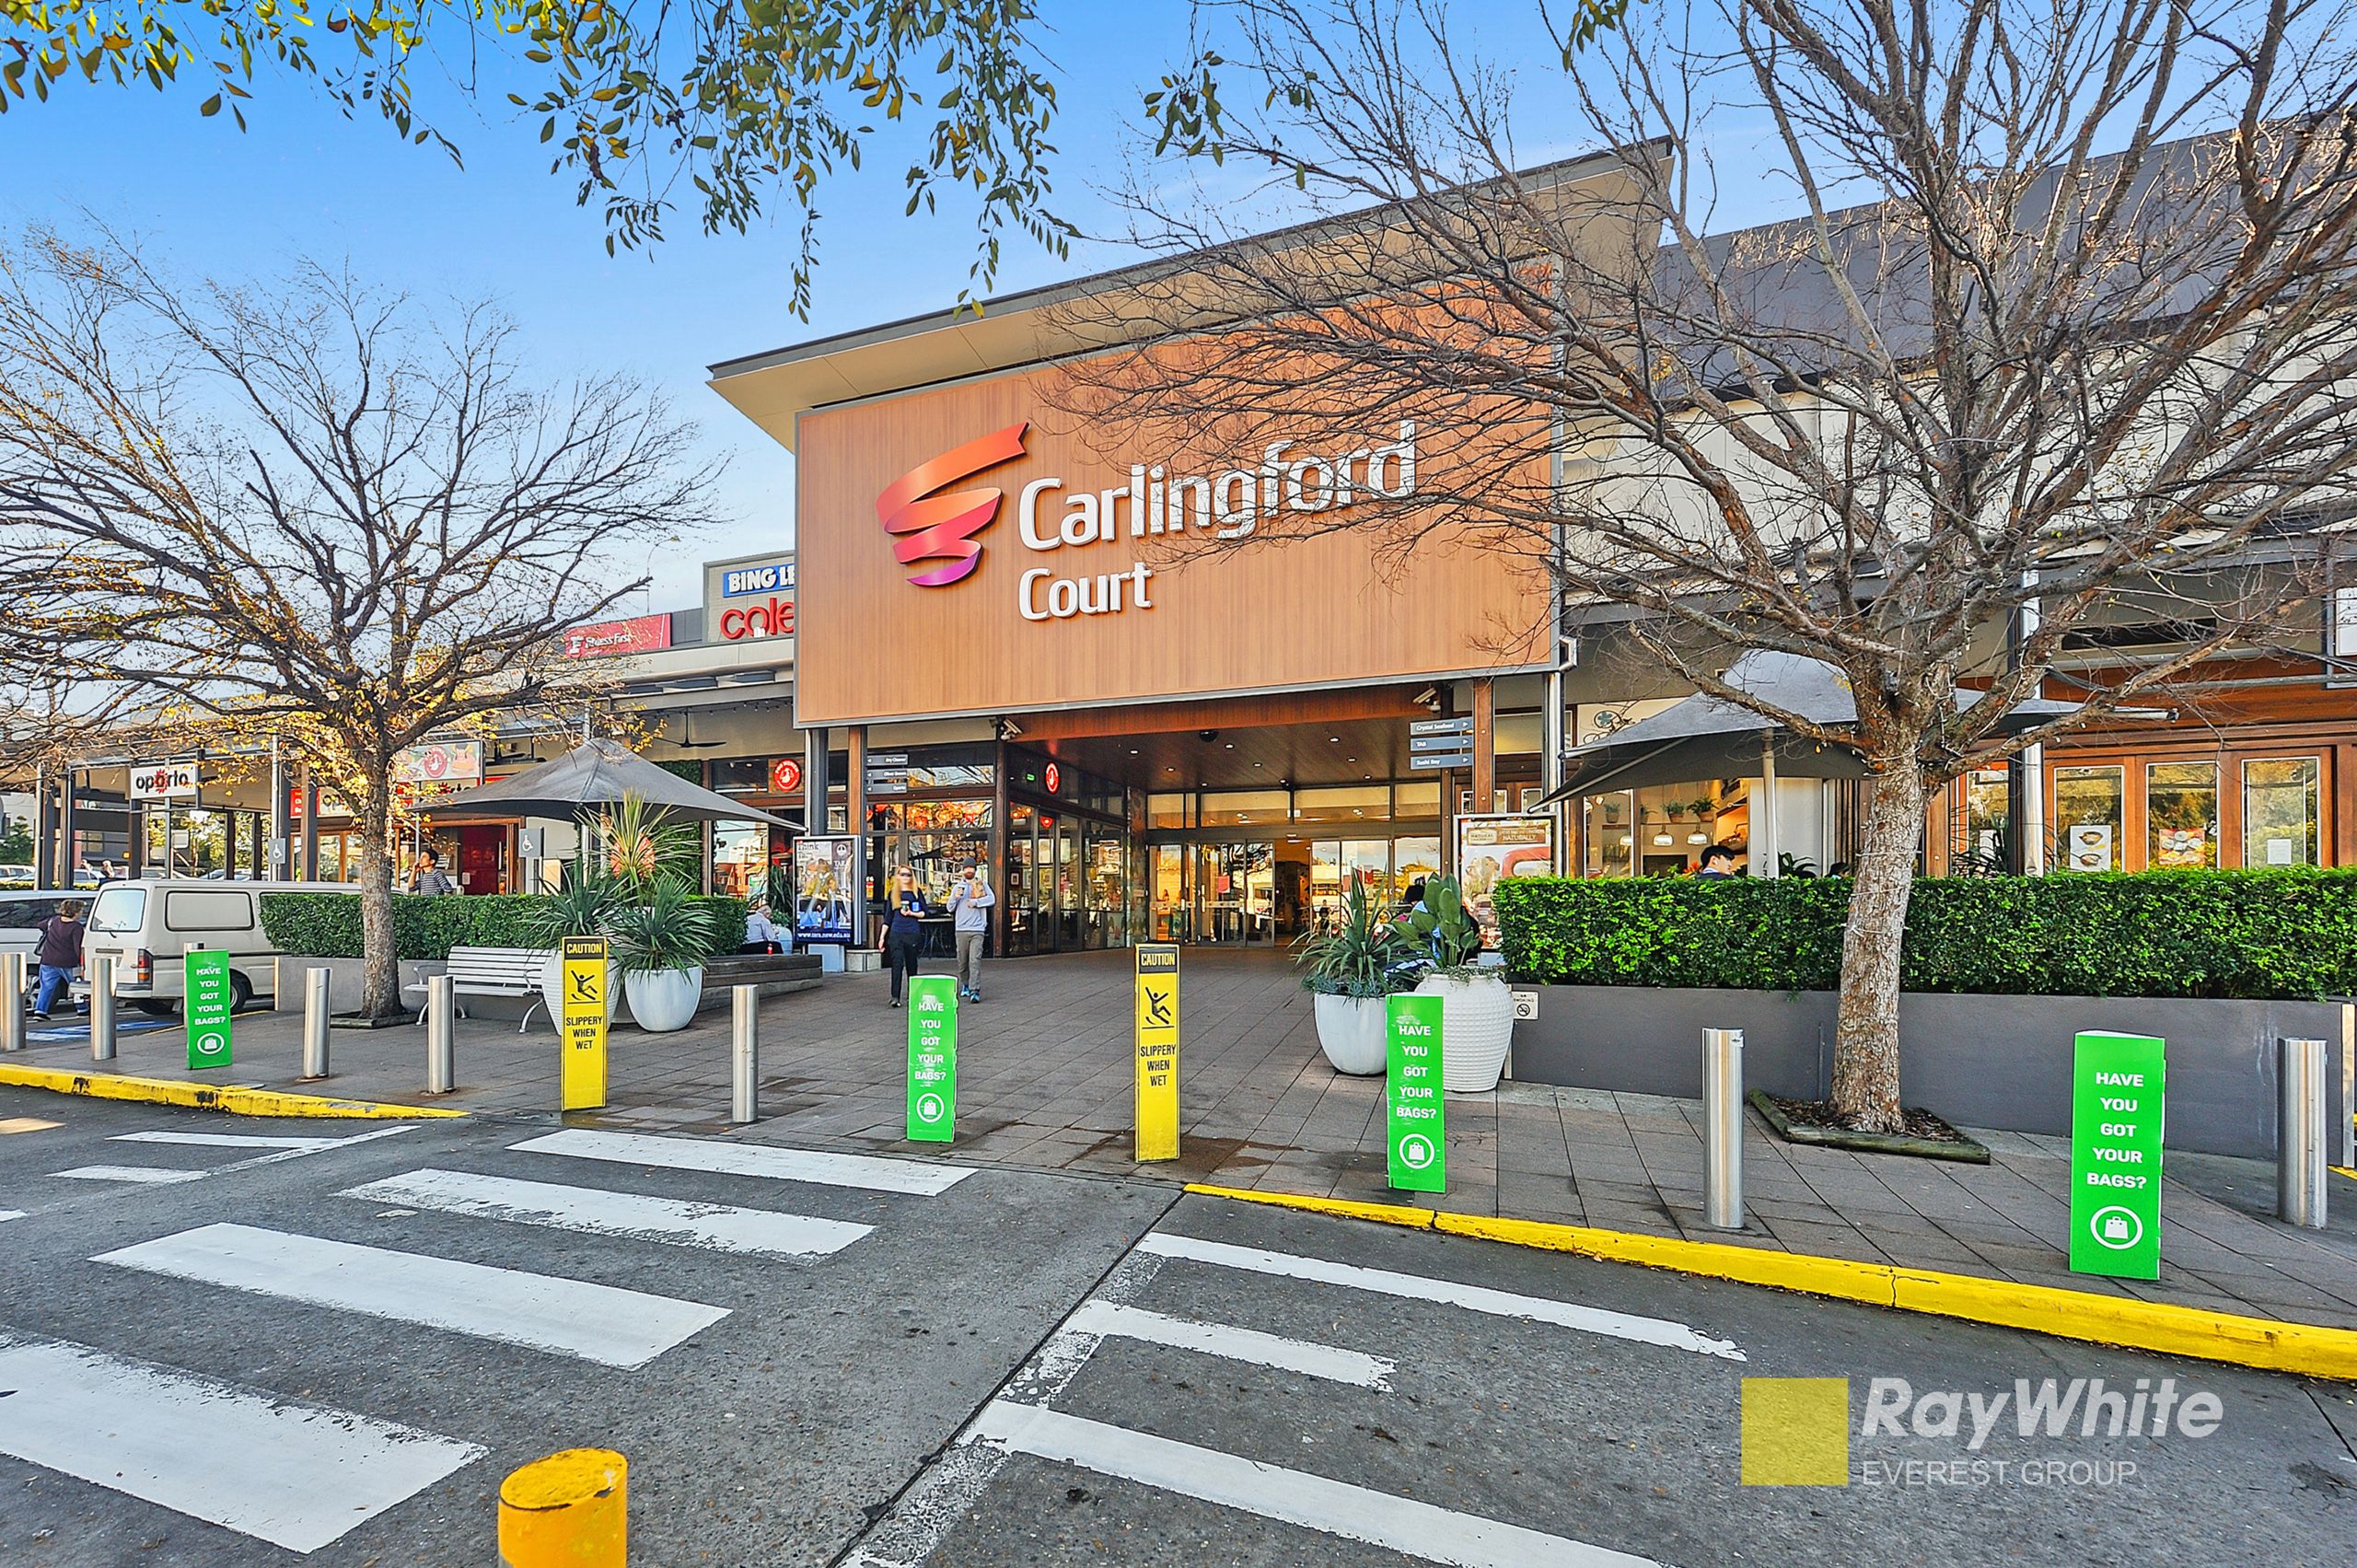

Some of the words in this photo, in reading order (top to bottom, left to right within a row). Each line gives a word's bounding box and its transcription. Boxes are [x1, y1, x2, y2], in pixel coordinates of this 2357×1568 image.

[1019, 420, 1417, 551] Carlingford
[728, 567, 777, 593] BING
[779, 565, 795, 587] LE
[1019, 562, 1153, 621] Court
[720, 598, 795, 640] cole
[136, 770, 190, 793] oporto
[566, 943, 602, 954] CAUTION
[1141, 953, 1176, 966] CAUTION
[196, 968, 222, 976] HAVE
[199, 980, 219, 988] YOU
[200, 993, 219, 1001] GOT
[197, 1005, 223, 1013] YOUR
[918, 1002, 945, 1012] HAVE
[194, 1016, 226, 1026] BAGS?
[565, 1016, 603, 1027] SLIPPERY
[921, 1019, 941, 1029] YOU
[573, 1028, 596, 1038] WHEN
[1399, 1025, 1432, 1037] HAVE
[575, 1040, 594, 1050] WET
[921, 1036, 941, 1047] GOT
[1140, 1044, 1177, 1057] SLIPPERY
[1402, 1045, 1428, 1057] YOU
[917, 1053, 944, 1063] YOUR
[1146, 1060, 1170, 1072] WHEN
[1403, 1066, 1429, 1078] GOT
[914, 1070, 946, 1081] BAGS?
[1149, 1074, 1167, 1086] WET
[2096, 1072, 2144, 1087] HAVE
[1399, 1086, 1434, 1098] YOUR
[2100, 1097, 2138, 1112] YOU
[1396, 1106, 1437, 1120] BAGS?
[2100, 1122, 2137, 1138] GOT
[2092, 1147, 2143, 1164] YOUR
[2086, 1172, 2147, 1190] BAGS?
